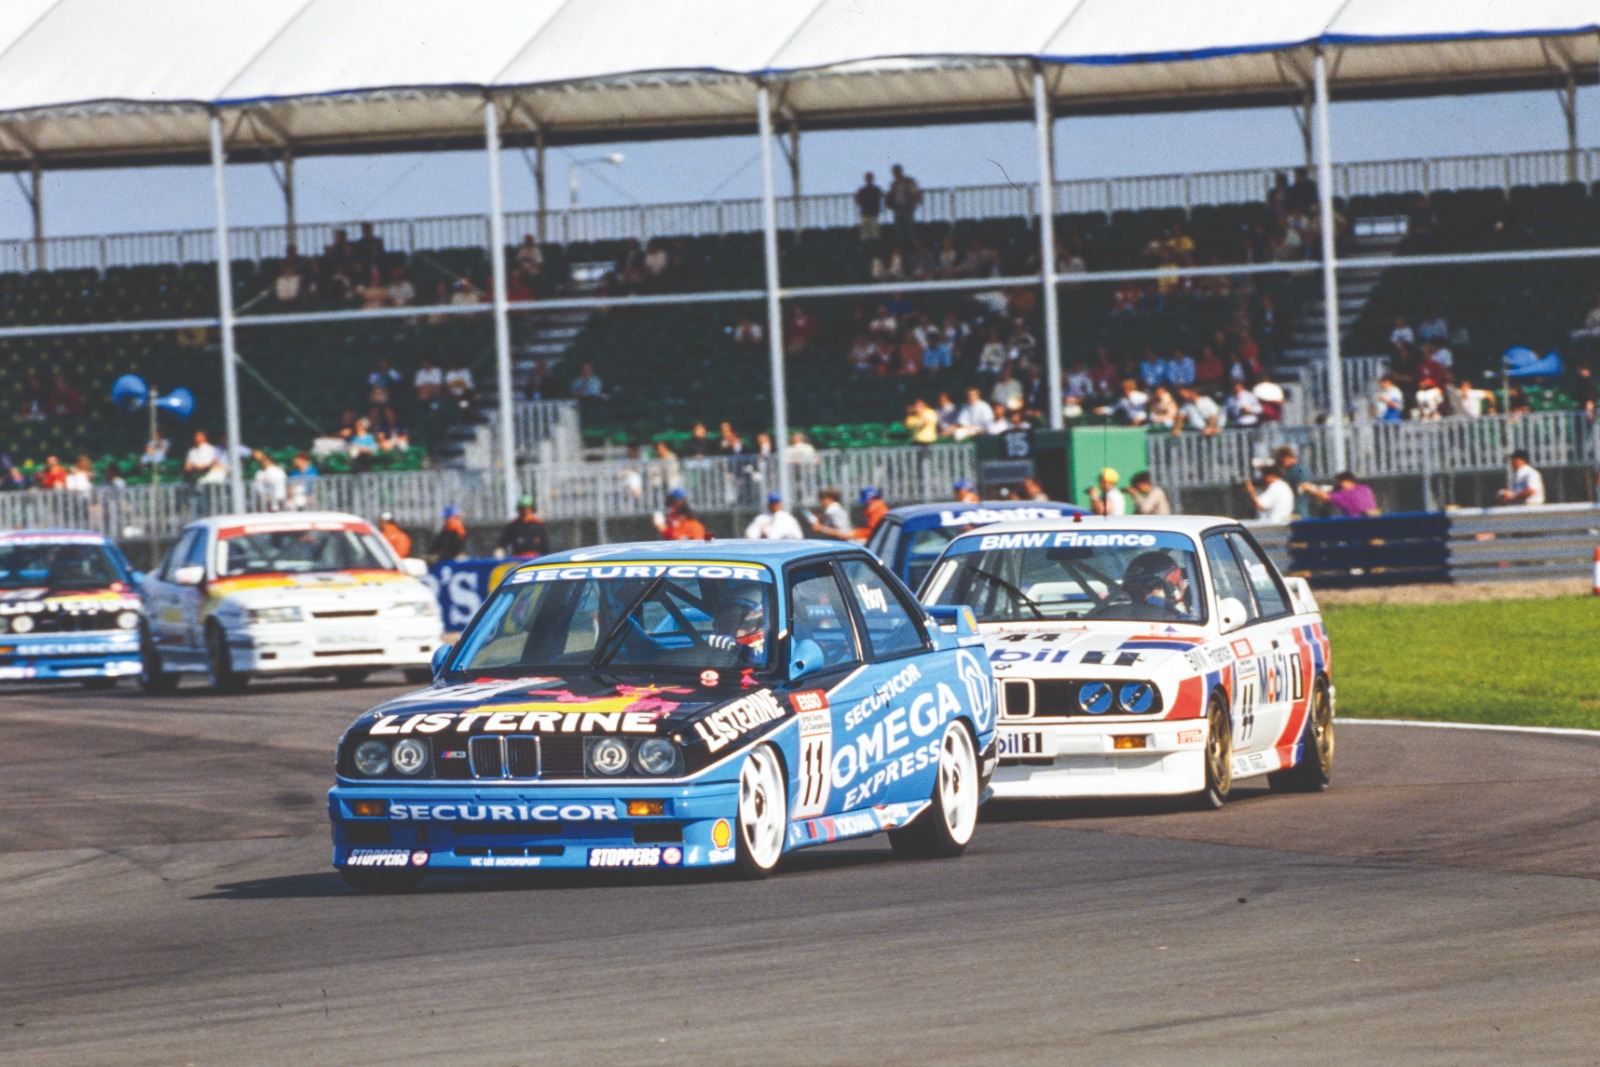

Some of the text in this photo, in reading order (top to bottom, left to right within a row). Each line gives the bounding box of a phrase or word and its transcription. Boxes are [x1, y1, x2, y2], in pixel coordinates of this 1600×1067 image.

[980, 532, 1157, 550] BMW Finance
[511, 566, 760, 584] SECURICOR
[857, 583, 888, 613] Hoy
[844, 663, 922, 731] SECURICOR
[369, 710, 657, 735] LISTERINE
[694, 688, 786, 753] LISTERINE
[830, 681, 962, 789] OMEGA
[803, 741, 824, 806] 11
[842, 739, 942, 812] EXPRESS
[389, 804, 618, 820] SECURICOR
[347, 849, 411, 866] STOPPERS
[589, 848, 661, 867] STOPPERS
